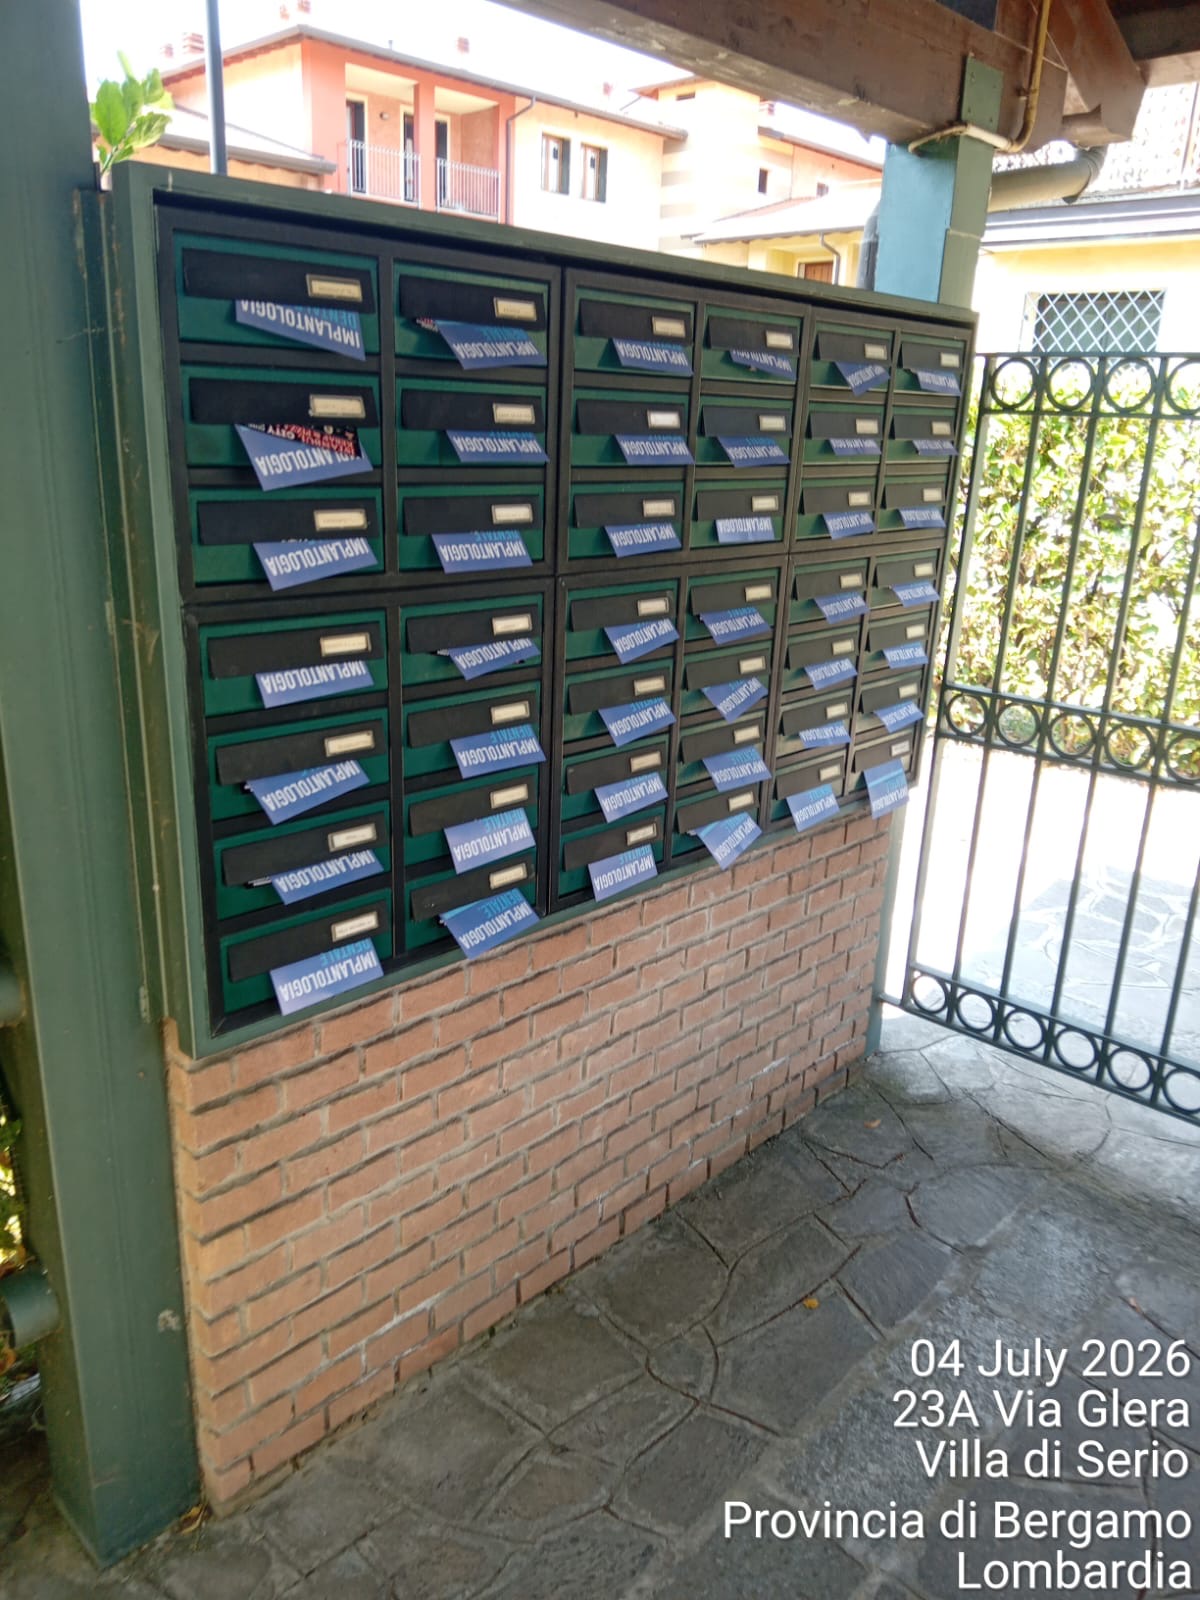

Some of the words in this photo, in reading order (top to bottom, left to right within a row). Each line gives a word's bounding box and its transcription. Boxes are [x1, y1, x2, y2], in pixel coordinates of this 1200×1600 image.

[240, 299, 360, 348] IMPLANTOLOGIA
[453, 341, 538, 359] IMPLANTOLOGIA
[615, 342, 688, 366] IMPLANTOLOGIA
[453, 437, 542, 453] IMPLANTOLOGIA
[620, 440, 689, 456] IMPLANTOLOGIA
[439, 541, 526, 562] IMPLANTOLOGIA
[610, 523, 677, 547] IMPLANTOLOGIA
[264, 537, 369, 576] IMPLANTOLOGIA
[614, 618, 674, 653] IMPLANTOLOGIA
[455, 637, 533, 670] IMPLANTOLOGIA
[261, 660, 367, 694] IMPLANTOLOGIA
[608, 701, 671, 736] IMPLANTOLOGIA
[458, 737, 540, 767] IMPLANTOLOGIA
[261, 760, 361, 811] IMPLANTOLOGIA
[601, 777, 664, 812] IMPLANTOLOGIA
[483, 808, 526, 832] DENTALE
[453, 822, 530, 862] IMPLANTOLOGIA
[275, 850, 376, 892] IMPLANTOLOGIA
[593, 853, 654, 891] IMPLANTOLOGIA
[459, 902, 533, 949] IMPLANTOLOGIA
[279, 951, 377, 1001] IMPLANTOLOGIA
